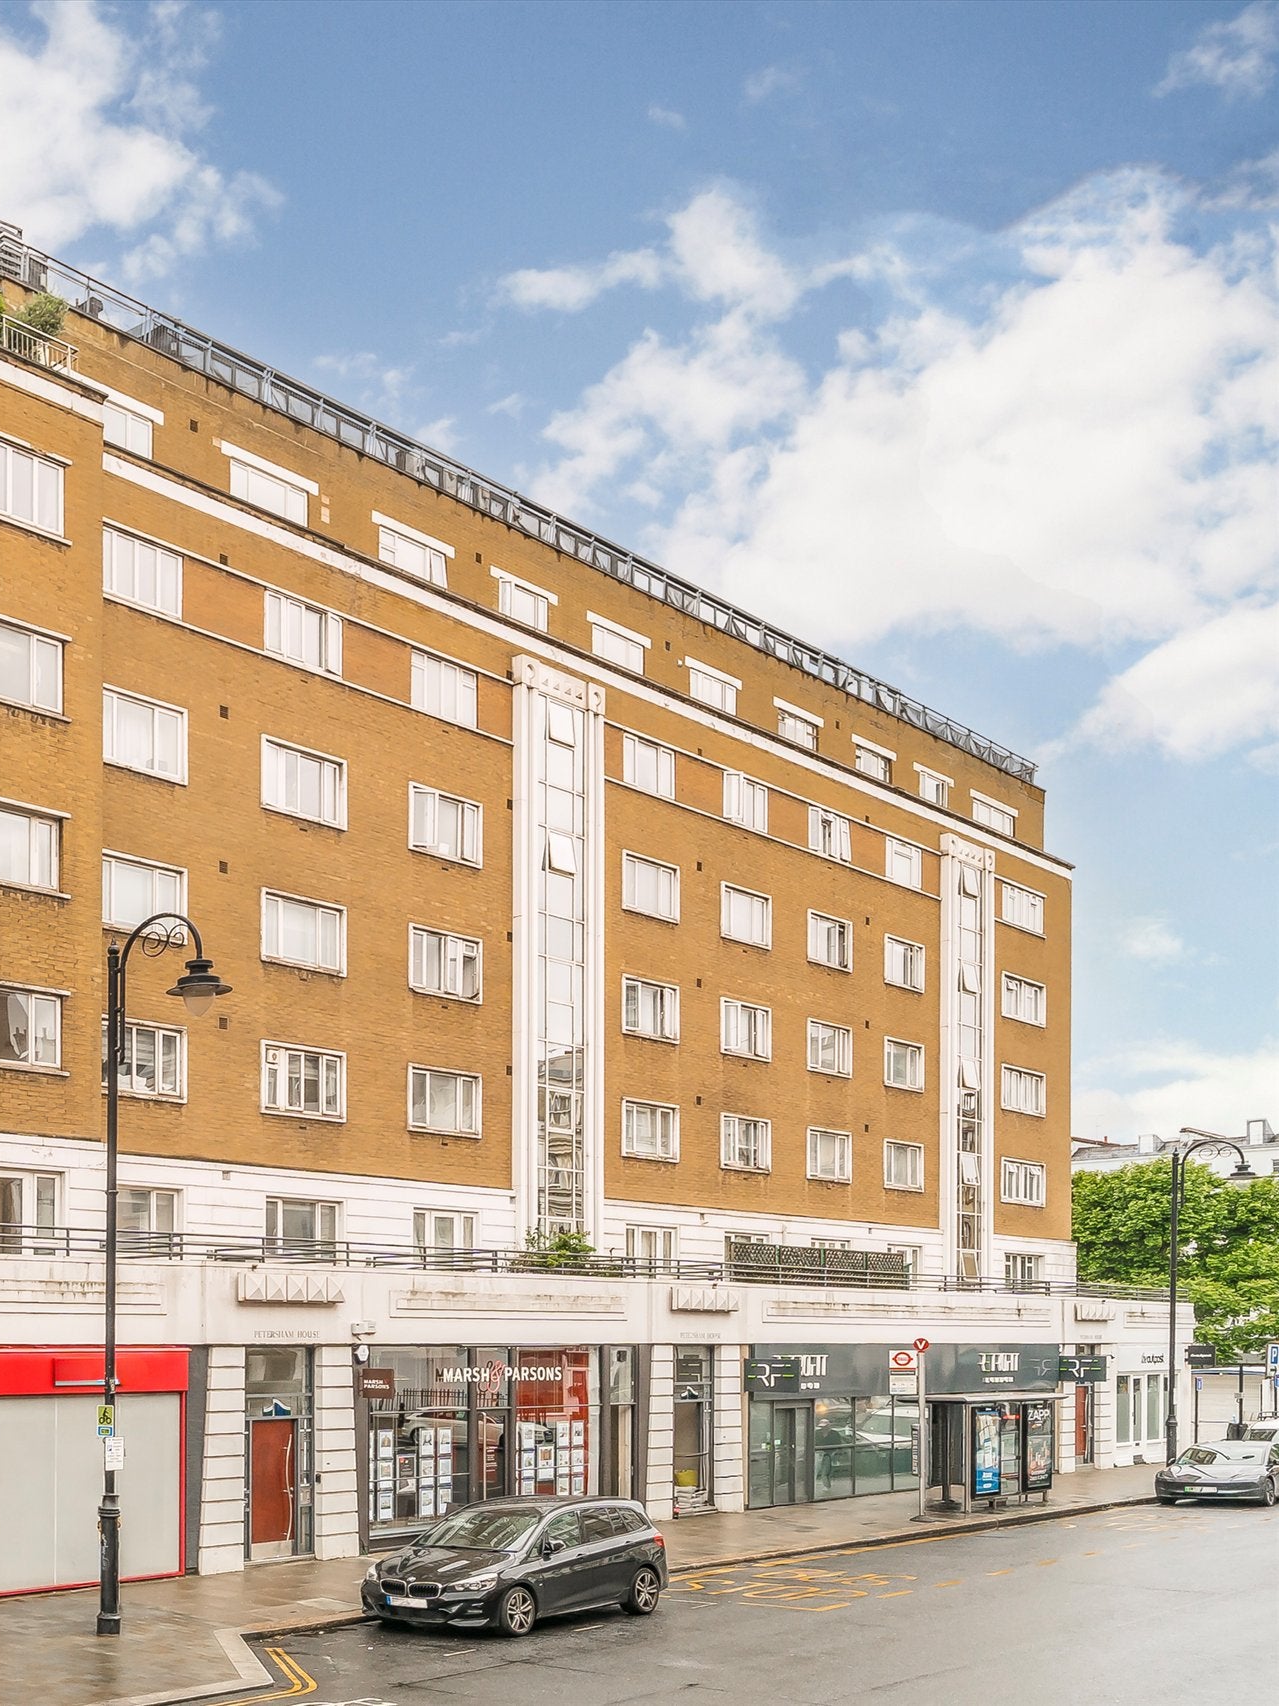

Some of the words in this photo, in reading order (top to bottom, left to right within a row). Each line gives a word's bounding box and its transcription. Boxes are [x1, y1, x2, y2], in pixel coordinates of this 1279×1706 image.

[254, 1330, 294, 1339] PETERSHAM
[297, 1330, 320, 1339] HOUSE
[915, 1340, 926, 1350] V
[443, 1367, 489, 1383] MARSH
[504, 1366, 562, 1381] PARSONS
[667, 1578, 869, 1602] STOP
